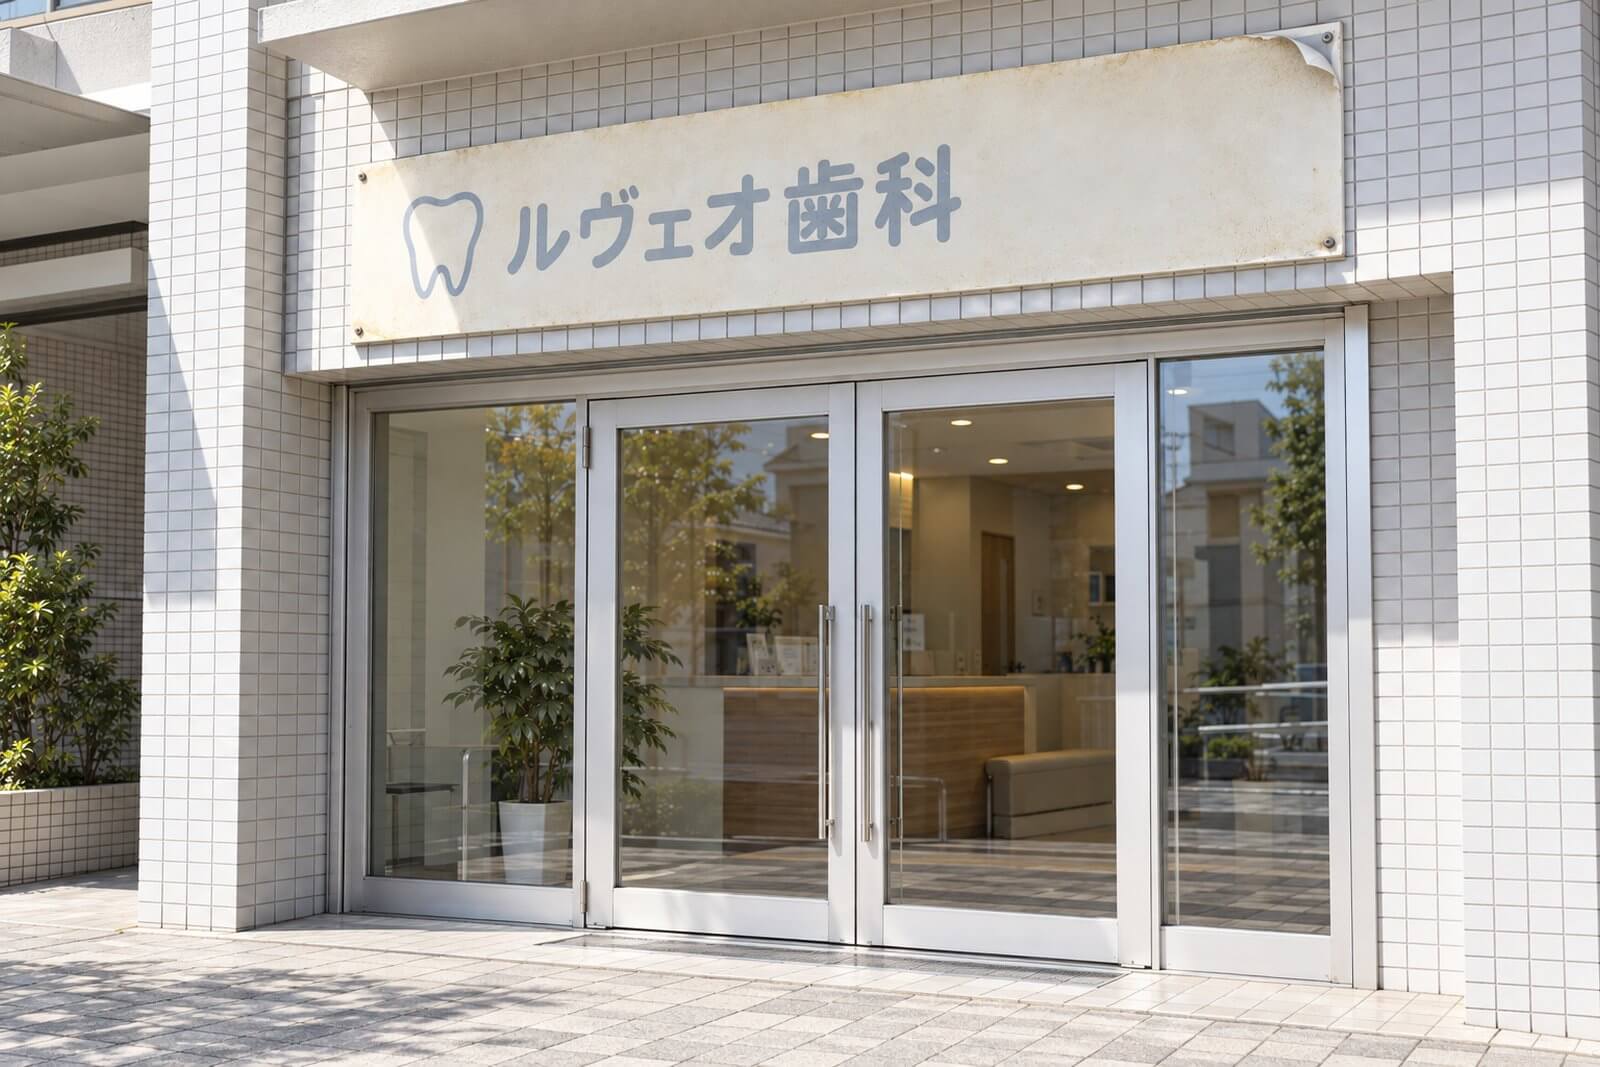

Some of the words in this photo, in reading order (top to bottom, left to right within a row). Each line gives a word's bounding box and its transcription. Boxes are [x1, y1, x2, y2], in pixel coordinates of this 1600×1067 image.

[507, 144, 962, 275] ルヴェオ歯科
